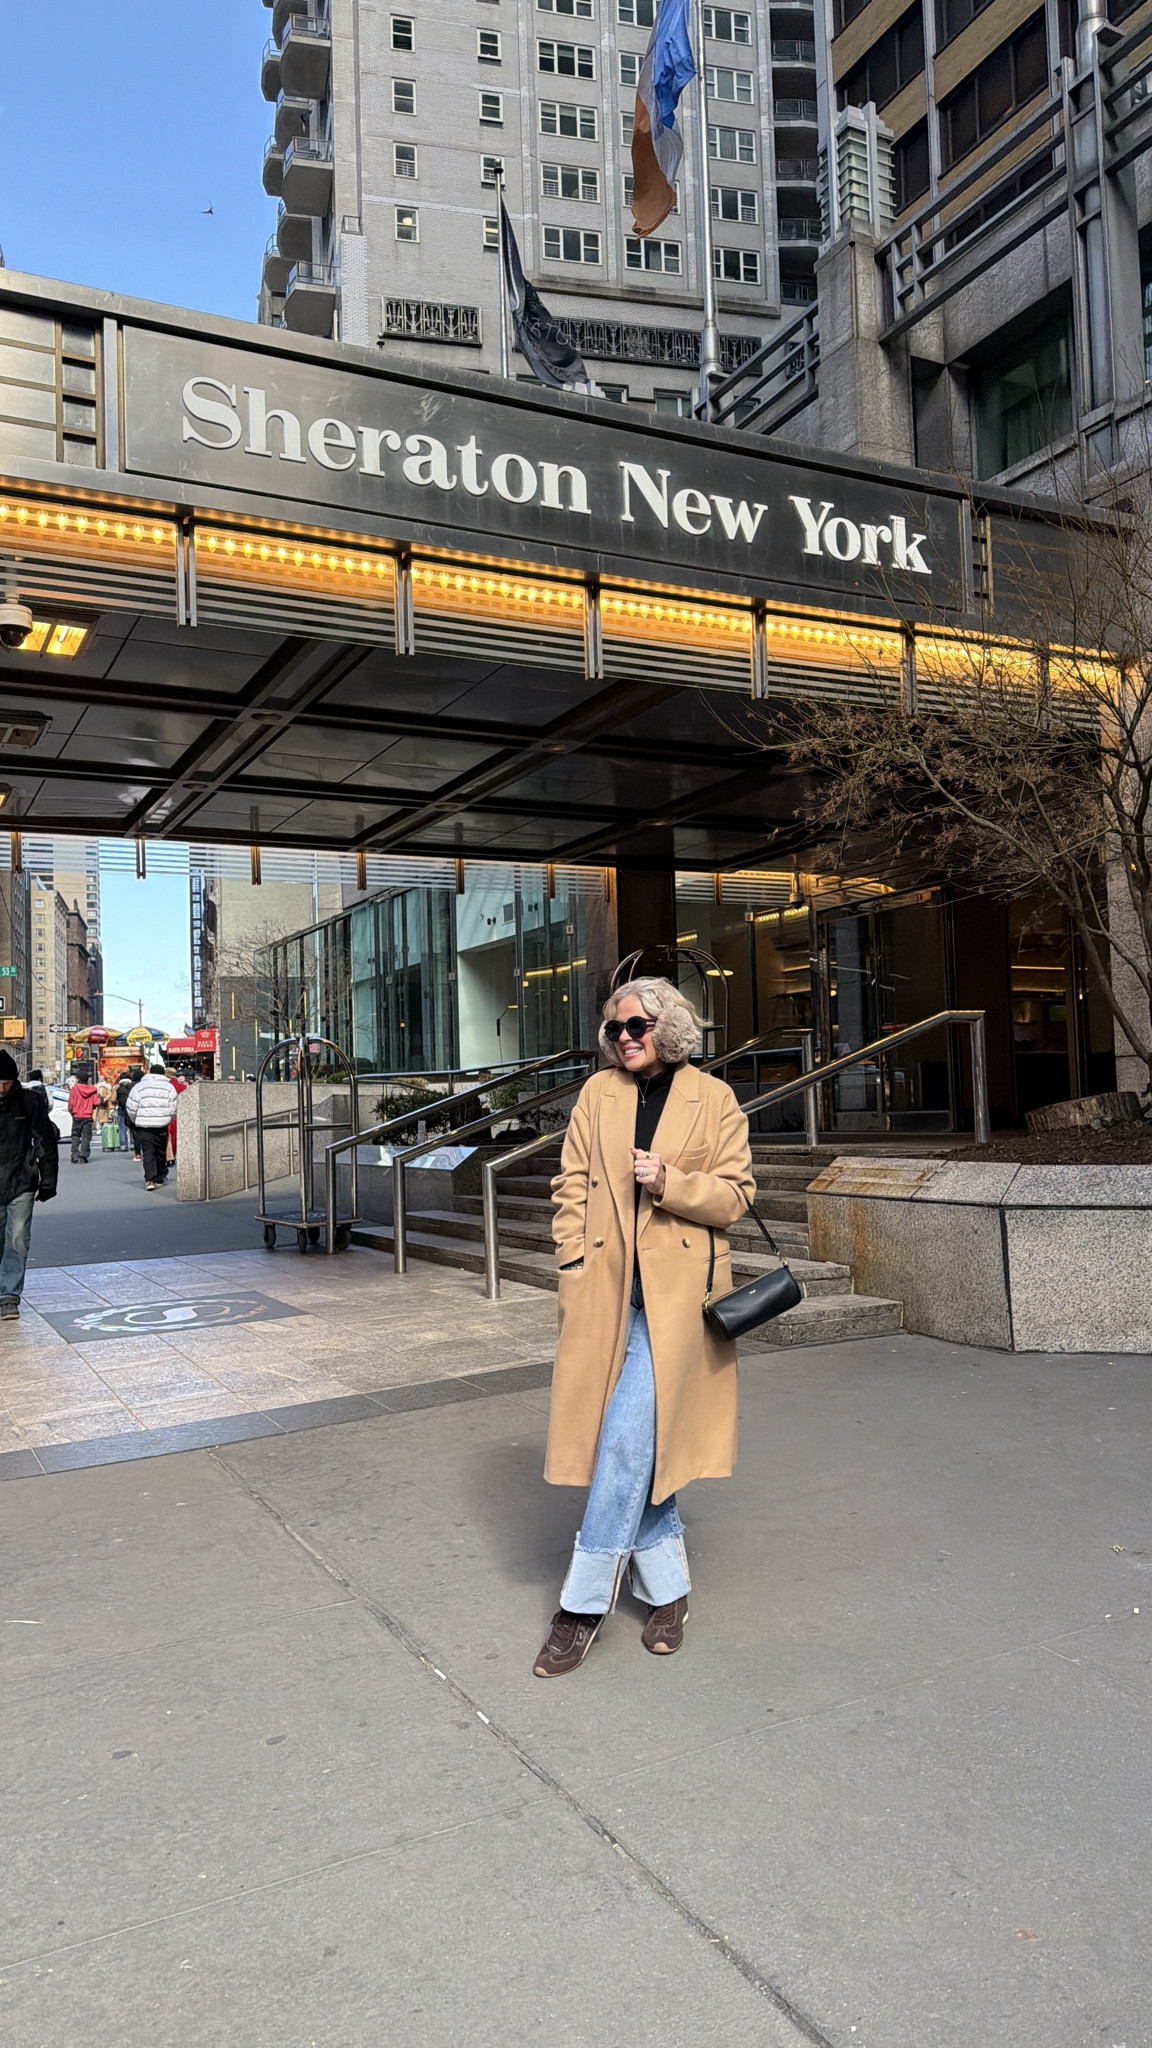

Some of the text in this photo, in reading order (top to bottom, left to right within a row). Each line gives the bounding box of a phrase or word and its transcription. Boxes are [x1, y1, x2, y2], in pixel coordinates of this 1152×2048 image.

[182, 376, 932, 575] Sheraton New York
[1, 967, 10, 976] 53
